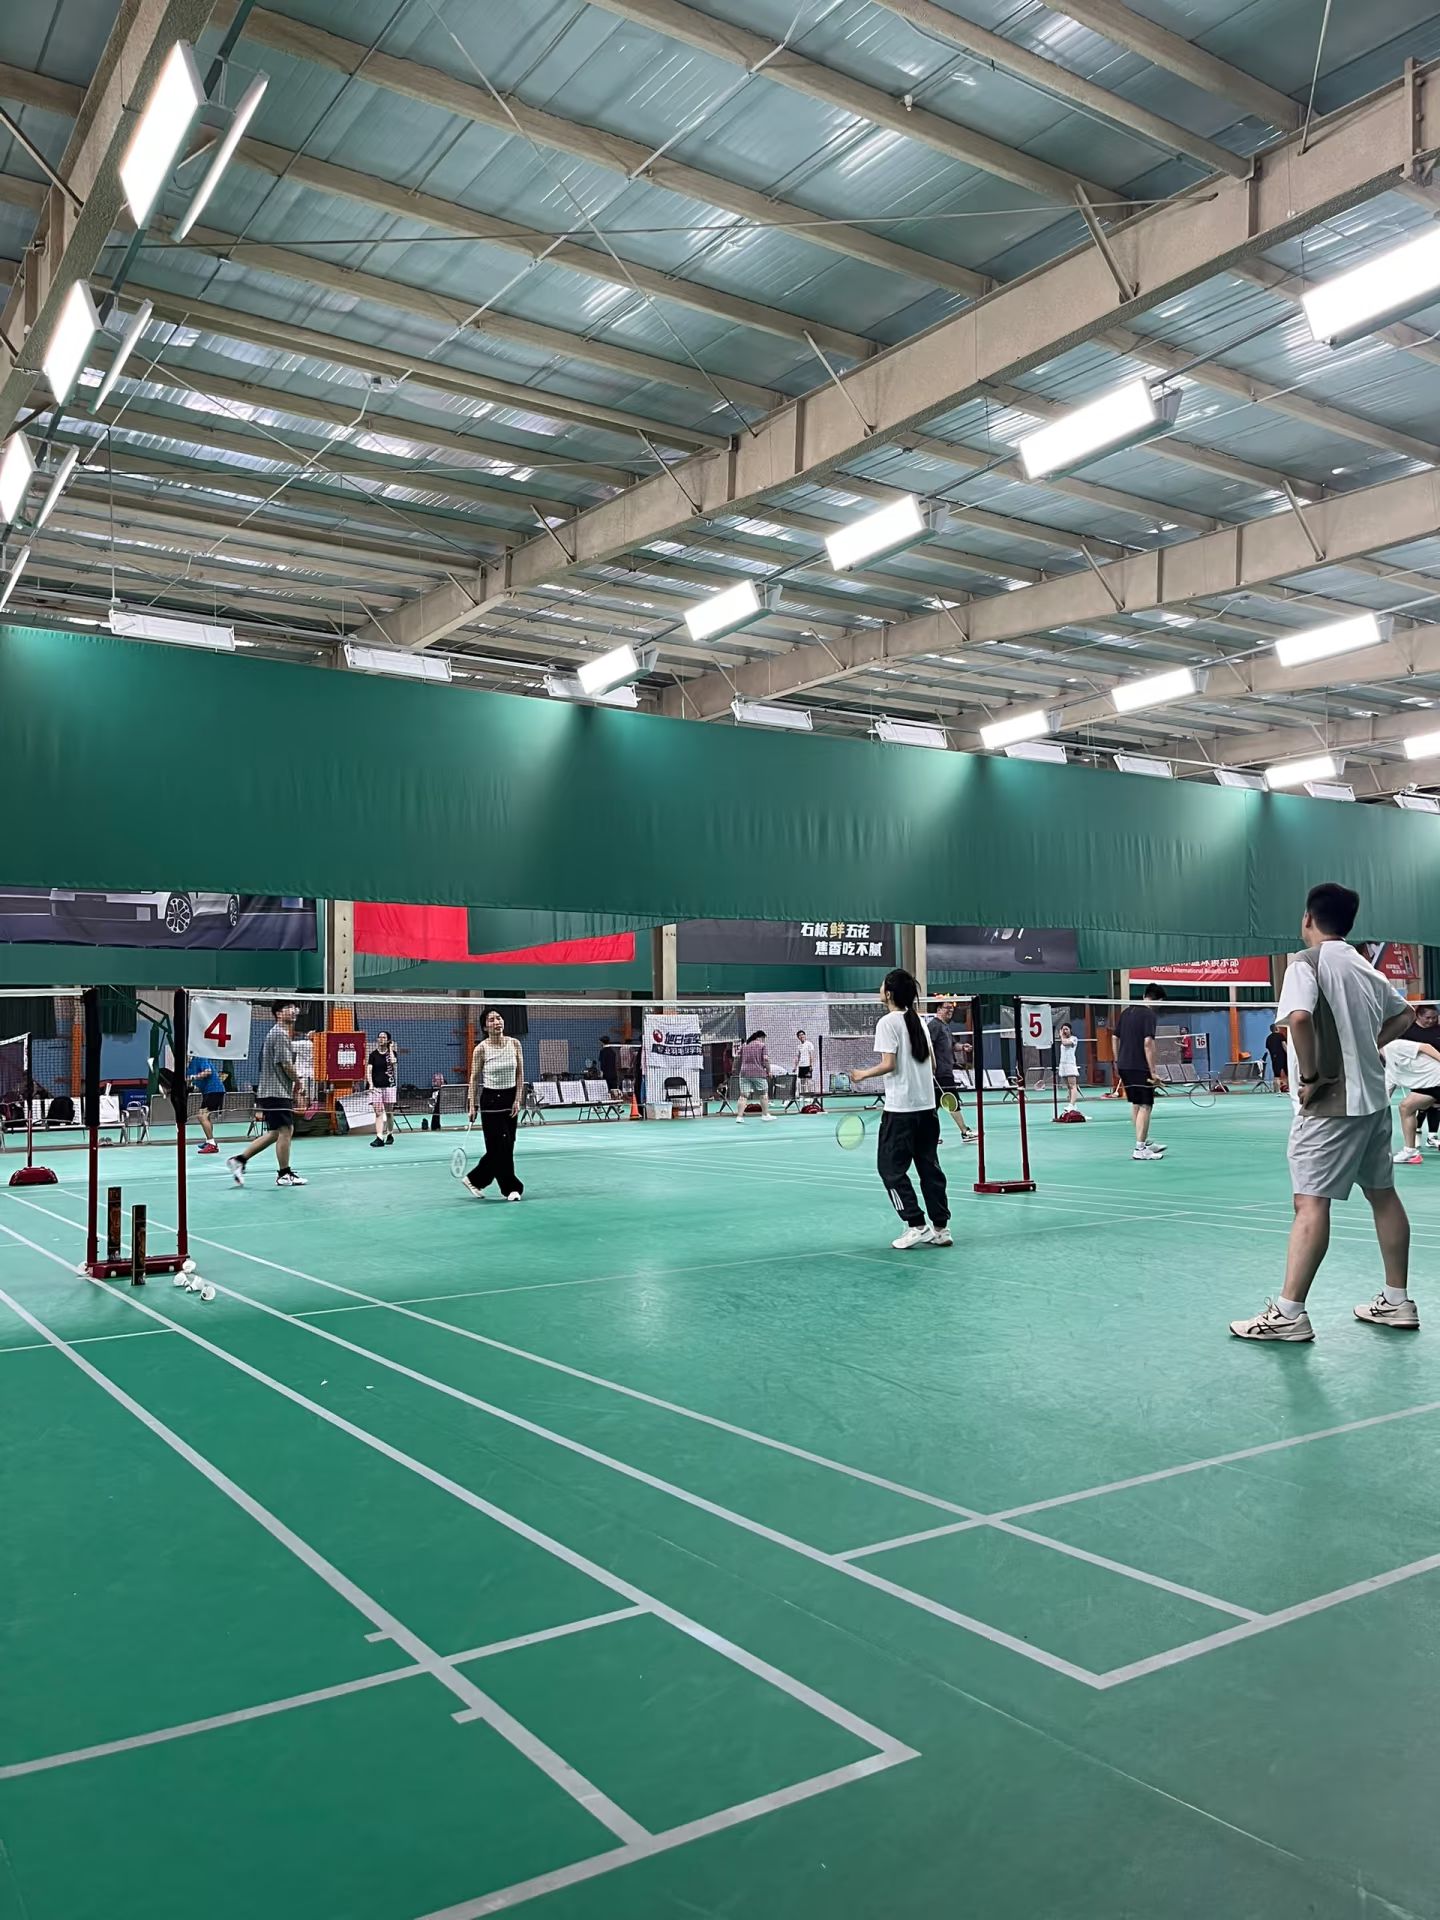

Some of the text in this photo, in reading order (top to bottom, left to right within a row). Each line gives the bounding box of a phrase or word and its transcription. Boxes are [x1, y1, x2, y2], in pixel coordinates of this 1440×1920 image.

[800, 922, 870, 939] 石板鲜五花
[814, 940, 883, 957] 焦香吃不腻
[1150, 965, 1173, 973] YOUCAN
[204, 1013, 231, 1047] 4
[1030, 1013, 1042, 1037] 5
[1197, 1038, 1205, 1046] 16
